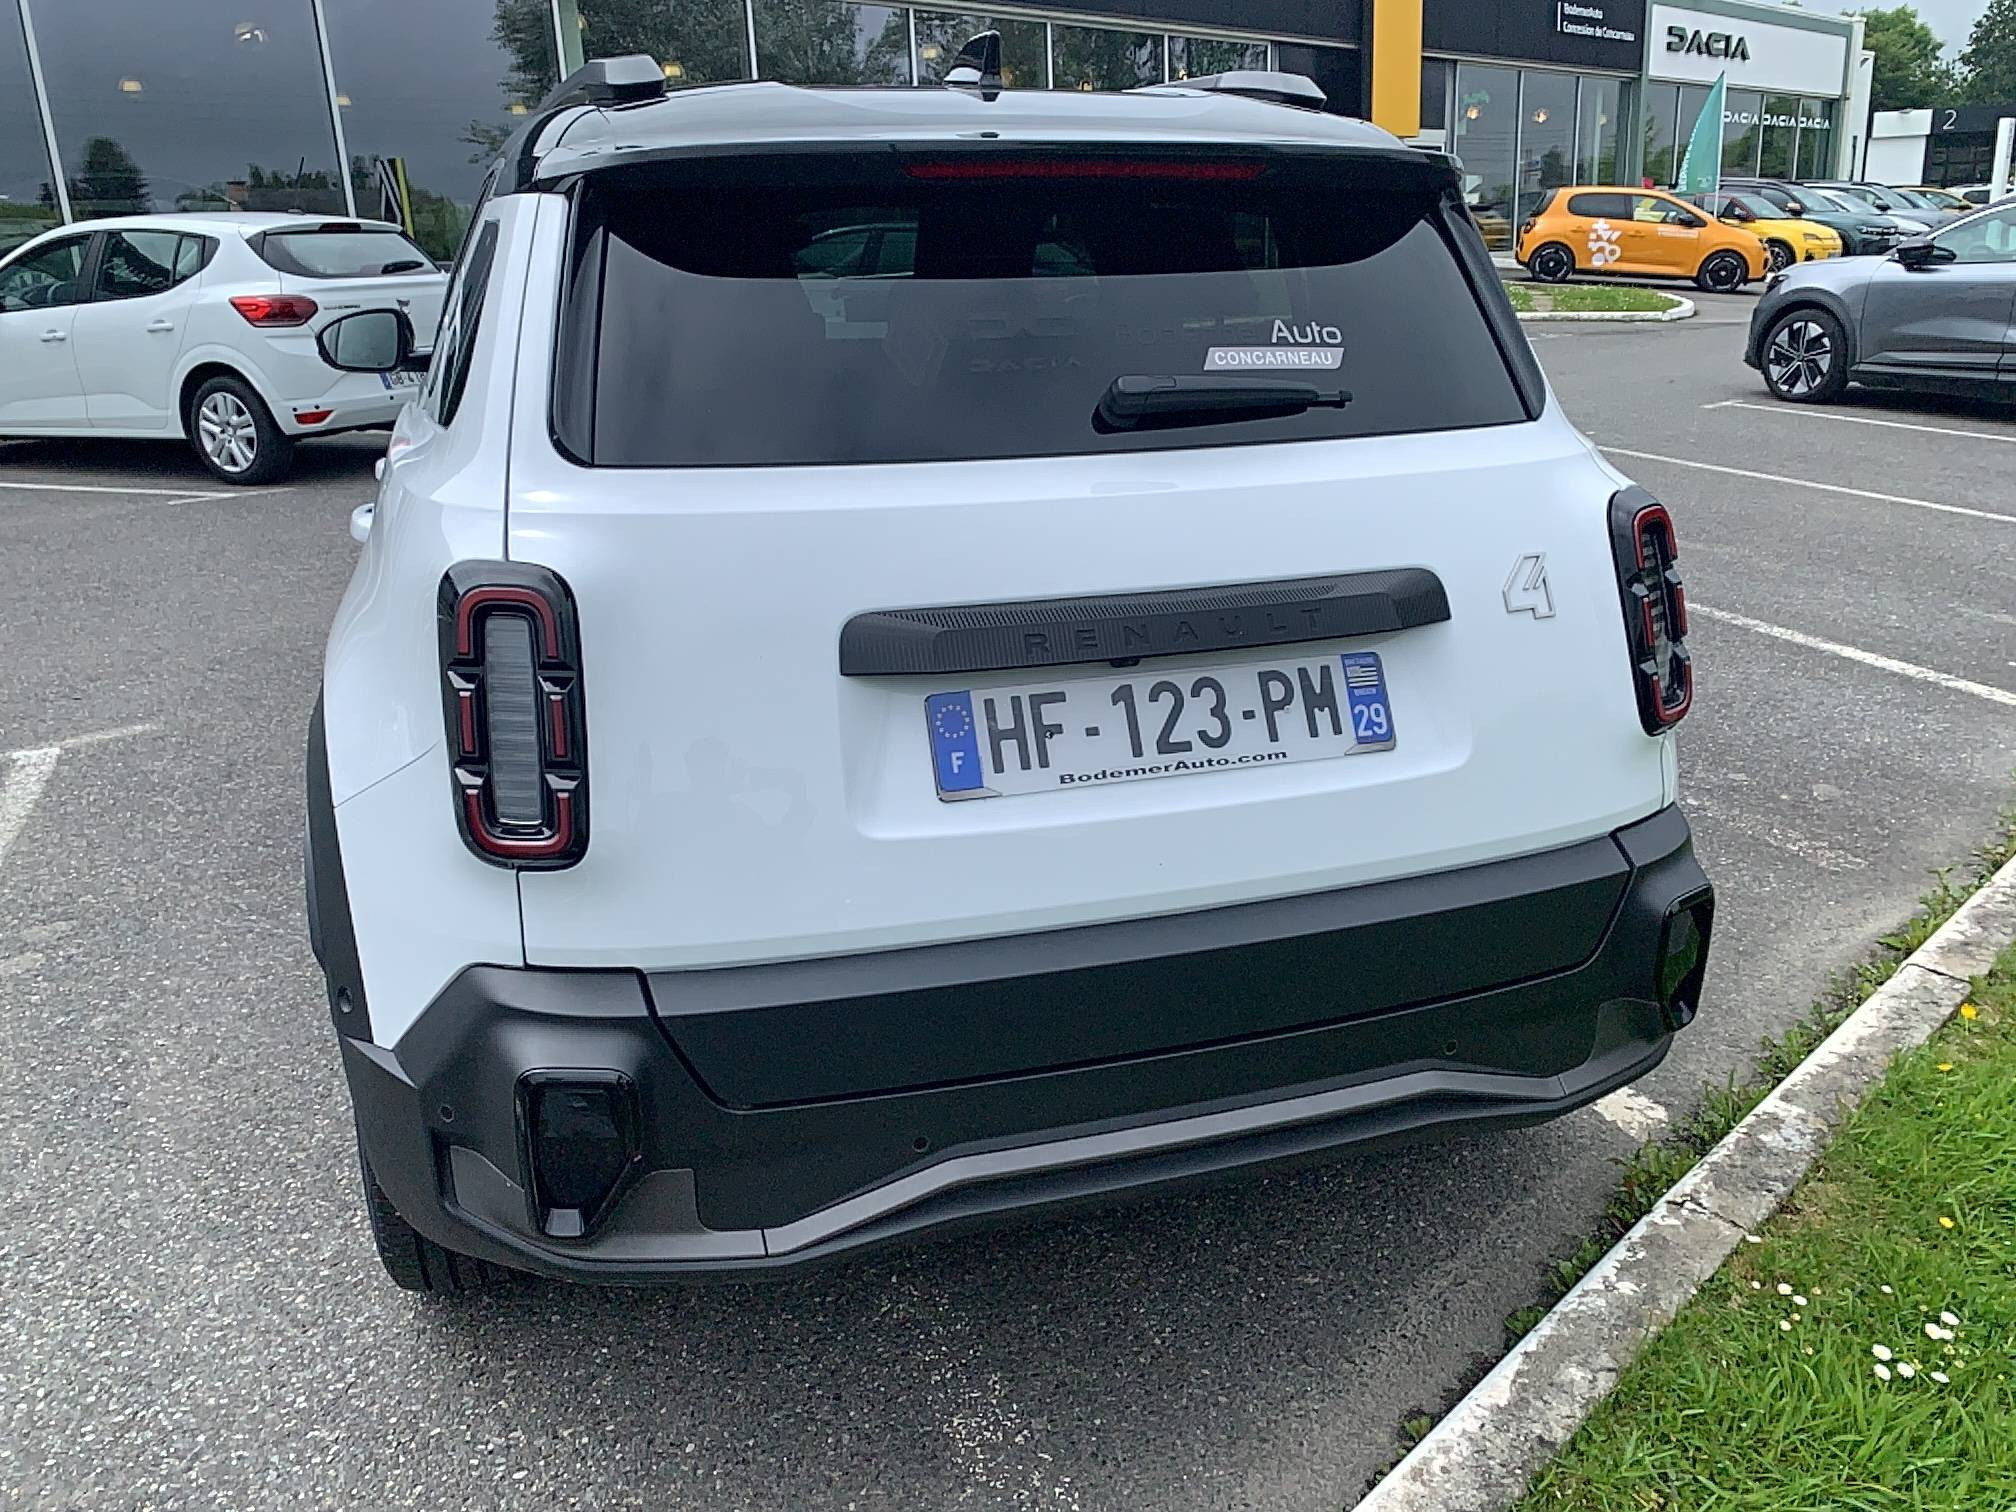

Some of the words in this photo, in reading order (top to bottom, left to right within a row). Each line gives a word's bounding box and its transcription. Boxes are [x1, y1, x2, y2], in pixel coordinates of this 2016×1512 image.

[1666, 25, 1750, 61] DACIA
[1724, 111, 1759, 125] DACIA
[1763, 113, 1797, 127] DACIA
[1800, 117, 1830, 129] DACIA
[1943, 109, 1957, 130] 2
[1271, 319, 1343, 344] Auto
[1214, 351, 1333, 366] CONCARNEAU
[1502, 552, 1556, 620] 4
[1023, 606, 1322, 659] RENAULT
[951, 751, 965, 774] F
[983, 664, 1343, 774] HF-123-PM
[1353, 702, 1389, 737] 29
[1059, 750, 1288, 785] BodemerAuto.com
